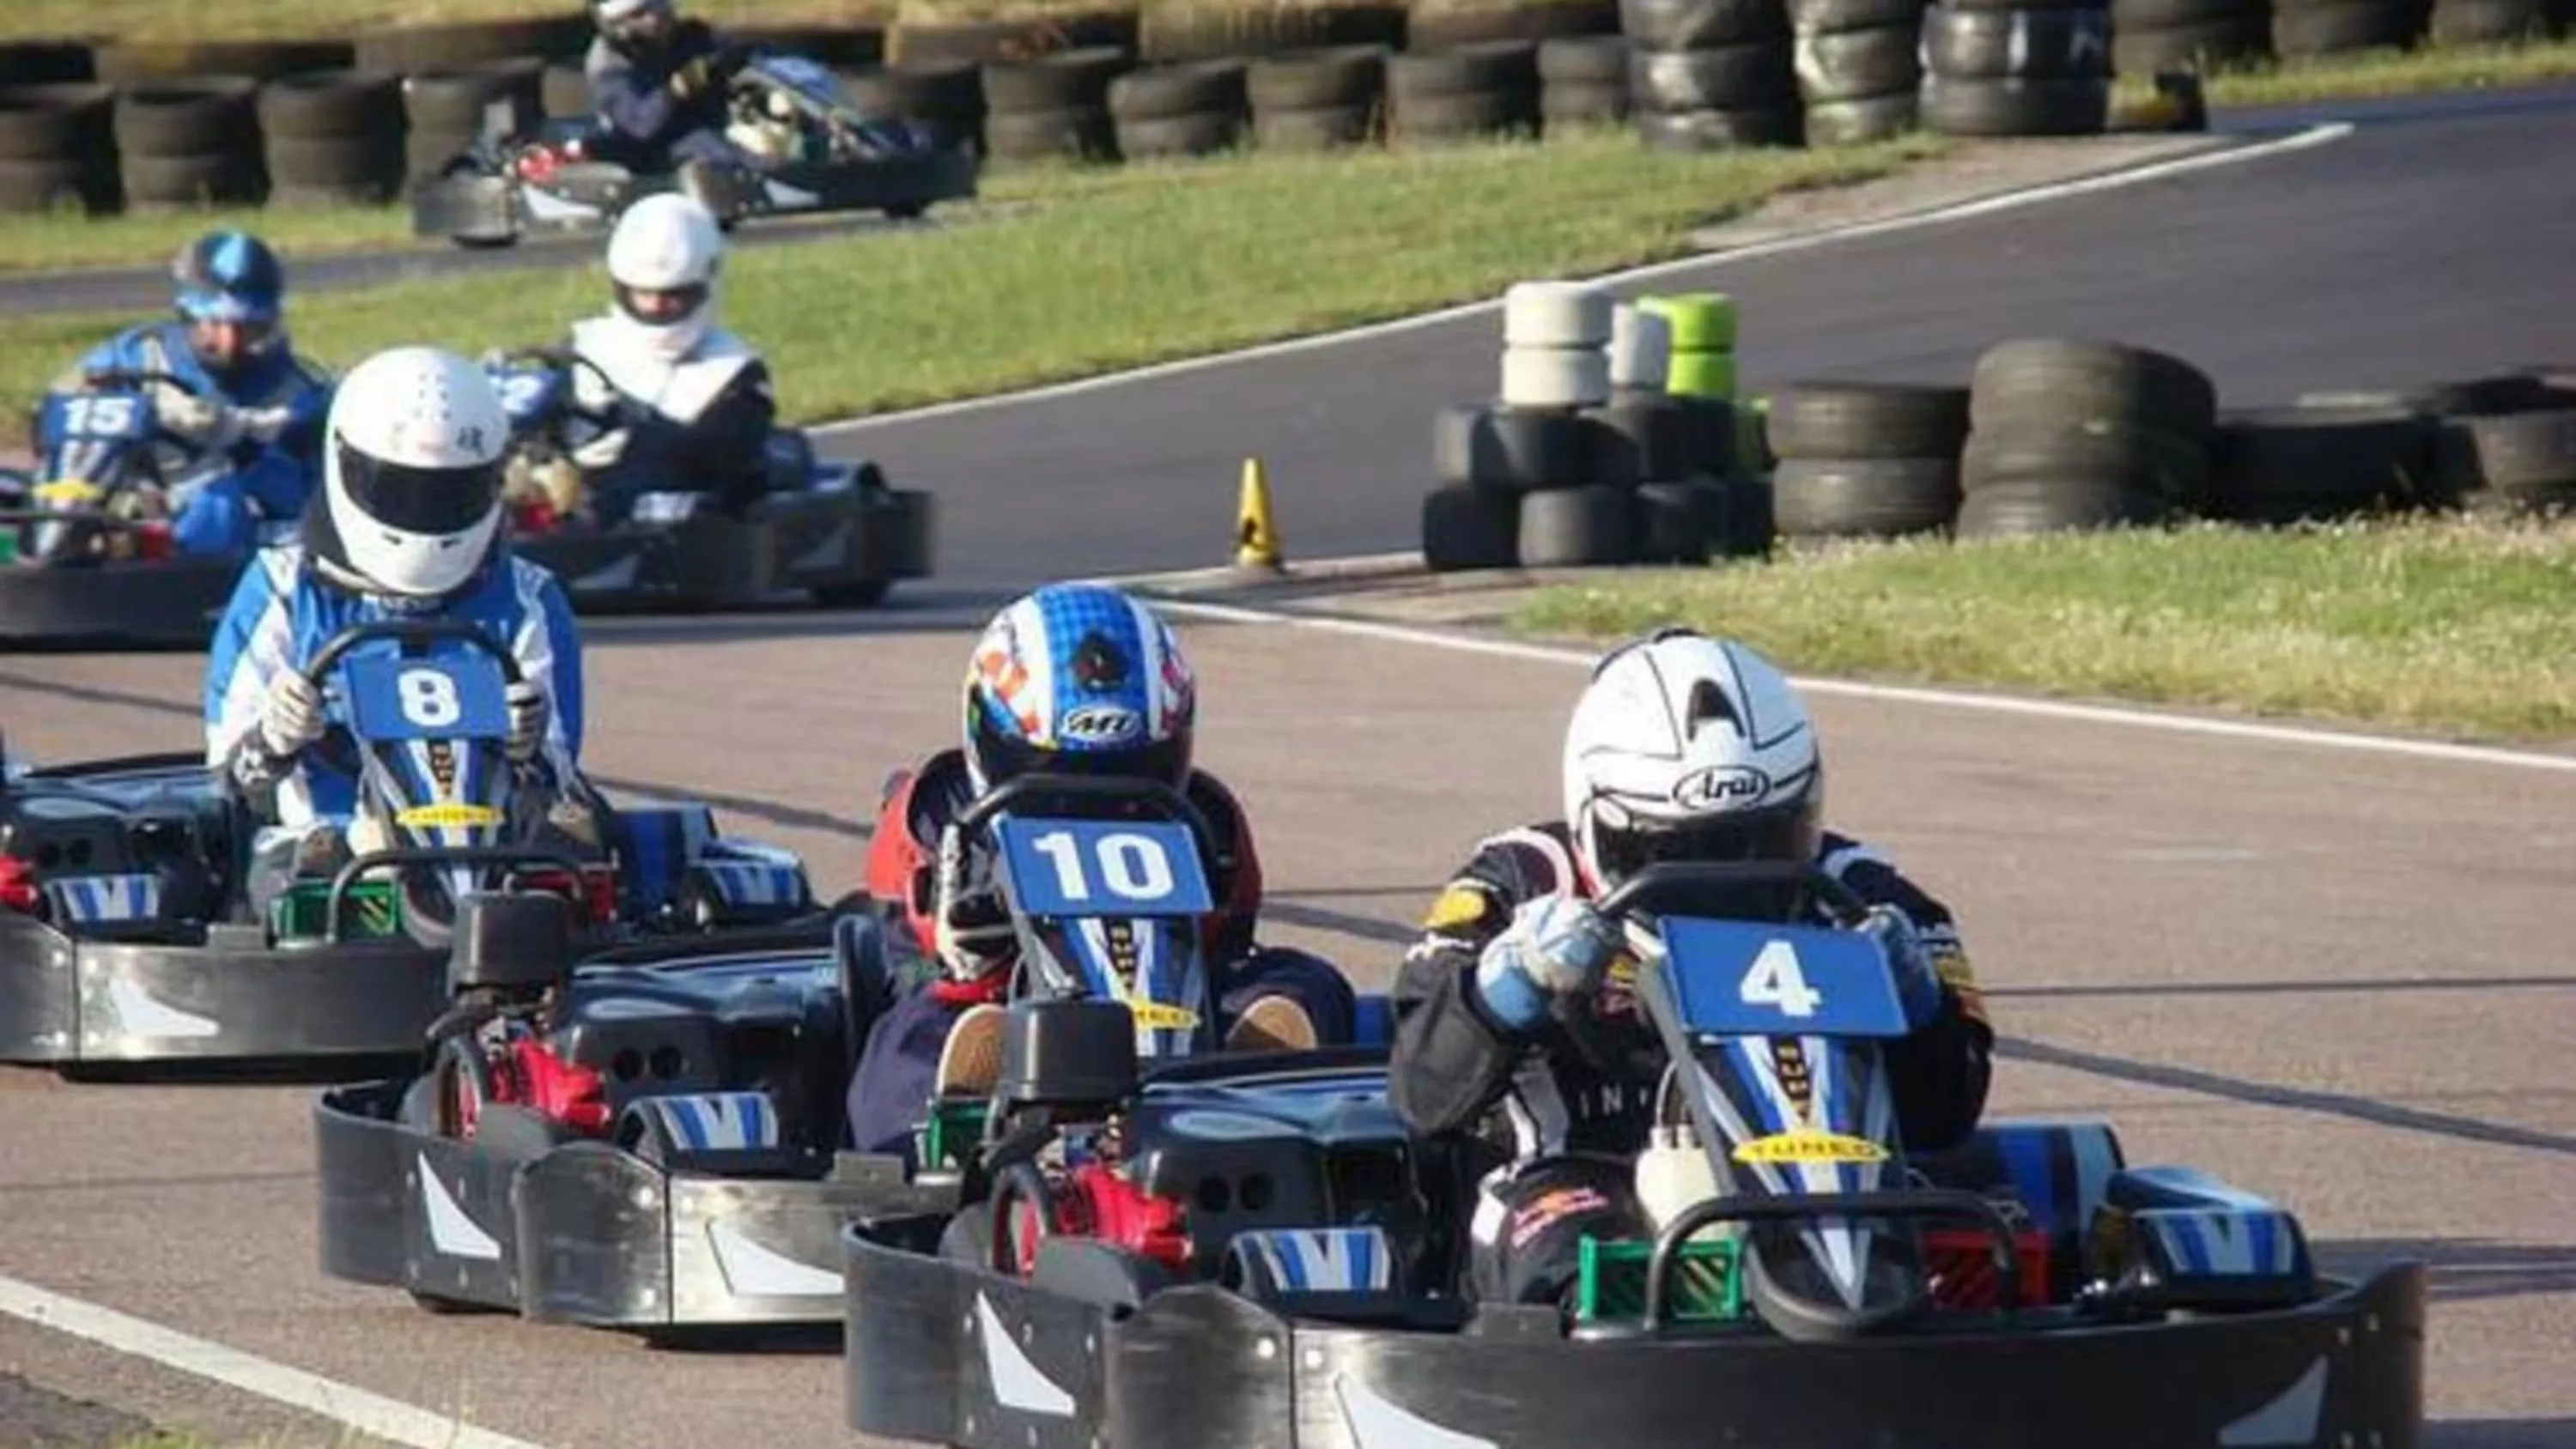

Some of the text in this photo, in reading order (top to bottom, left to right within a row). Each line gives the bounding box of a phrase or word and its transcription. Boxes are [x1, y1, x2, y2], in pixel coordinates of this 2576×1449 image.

[63, 398, 137, 433] 15
[398, 668, 460, 726] 8
[1681, 767, 1758, 803] Arai
[1032, 831, 1175, 900] 10
[1740, 939, 1821, 1016] 4
